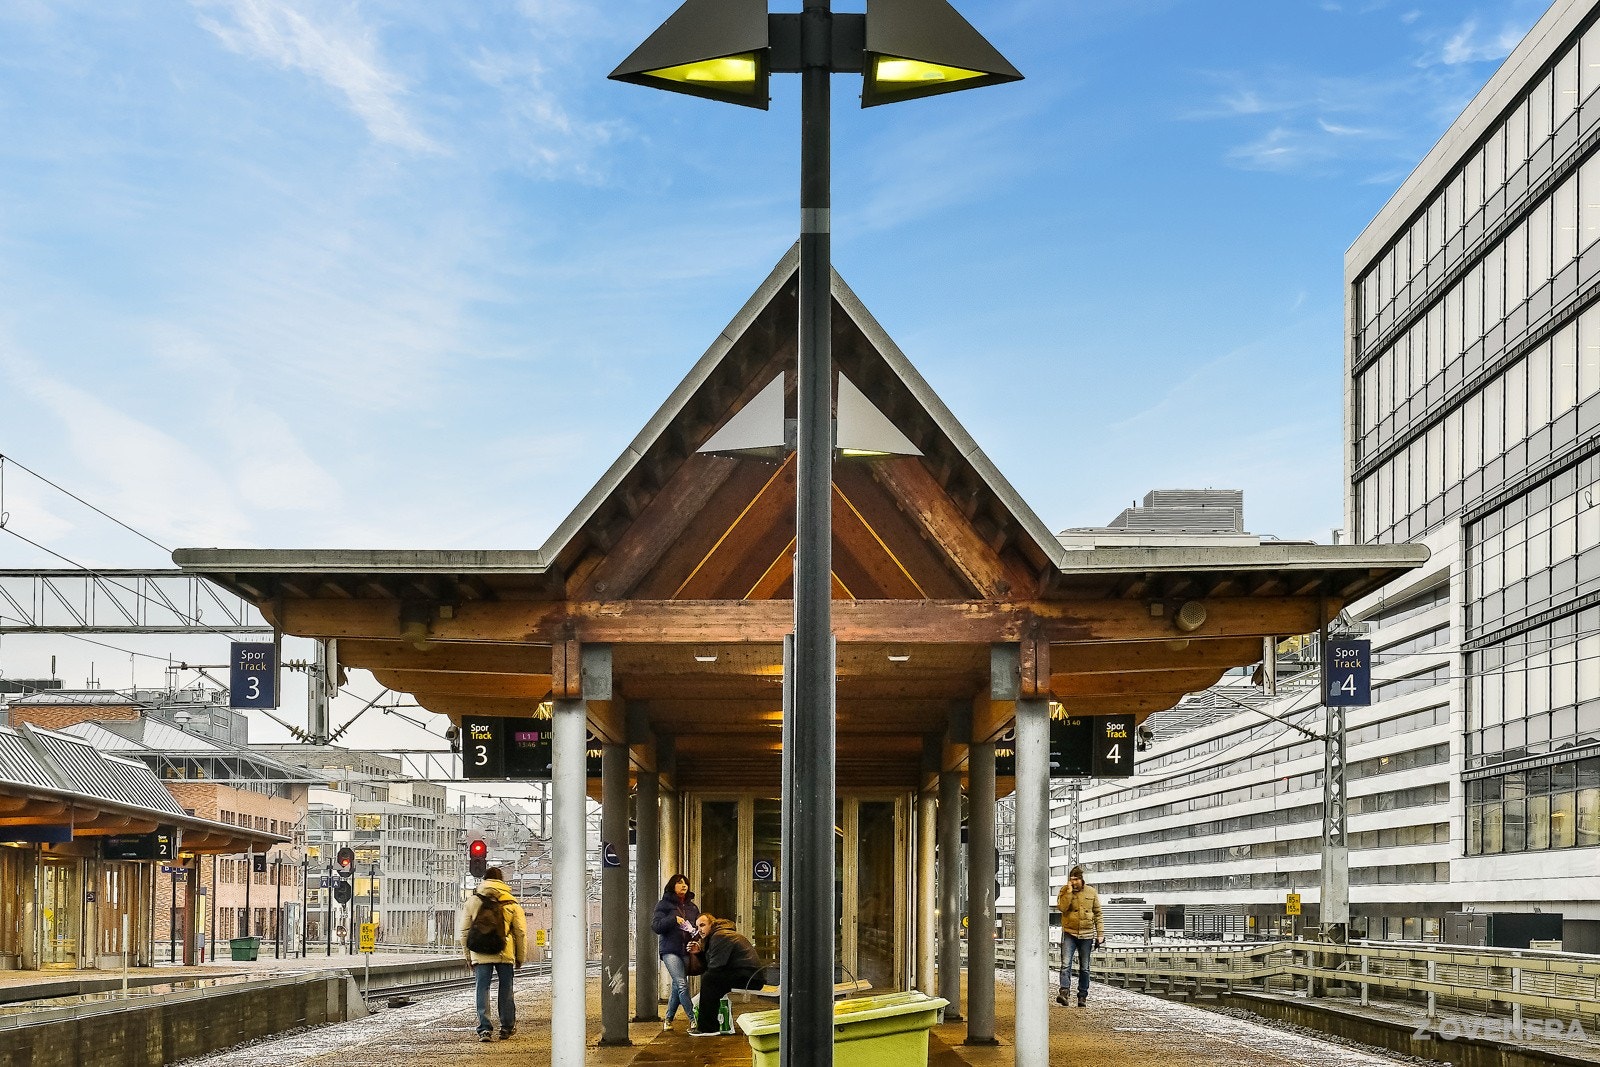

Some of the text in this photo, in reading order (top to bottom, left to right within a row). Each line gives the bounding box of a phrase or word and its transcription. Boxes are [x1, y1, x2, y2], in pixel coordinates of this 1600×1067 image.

[241, 650, 265, 661] Spor
[1335, 647, 1359, 659] Spor
[239, 661, 267, 671] Track
[1333, 659, 1362, 668] Track
[245, 676, 260, 700] 3
[1340, 674, 1357, 697] 4
[470, 723, 490, 732] Spor
[1106, 722, 1125, 731] Spor
[471, 731, 493, 740] Track
[1106, 729, 1128, 738] Track
[474, 745, 488, 766] 3
[1106, 743, 1121, 764] 4
[159, 844, 167, 855] 2
[257, 863, 262, 871] 2
